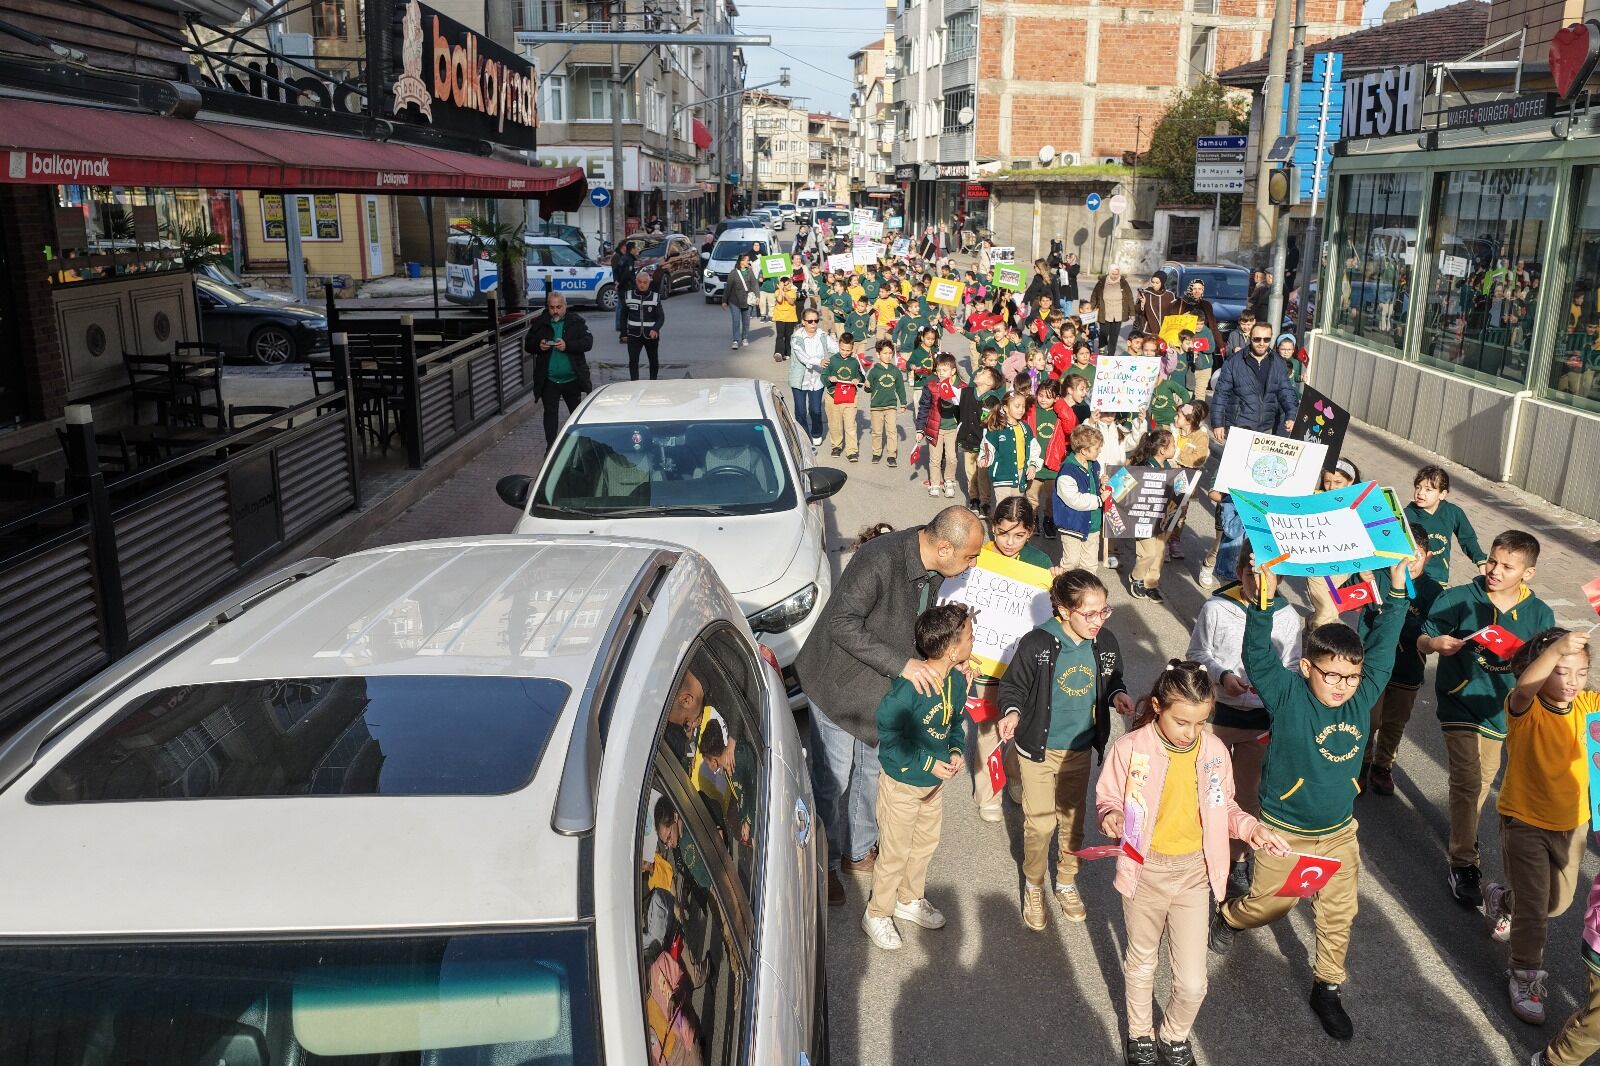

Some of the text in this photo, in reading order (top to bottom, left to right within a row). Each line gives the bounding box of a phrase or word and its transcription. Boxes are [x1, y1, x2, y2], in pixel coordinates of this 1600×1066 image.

[1342, 66, 1416, 137] NESH
[1448, 98, 1545, 125] WAFFLE BURGER COFFEE
[1198, 139, 1228, 147] Samsun
[32, 152, 110, 180] balkaymak
[560, 280, 587, 290] POLİS
[1270, 516, 1331, 530] MUTLU
[1274, 529, 1327, 541] OLMAYA
[1280, 542, 1359, 555] HAKKIM VAR
